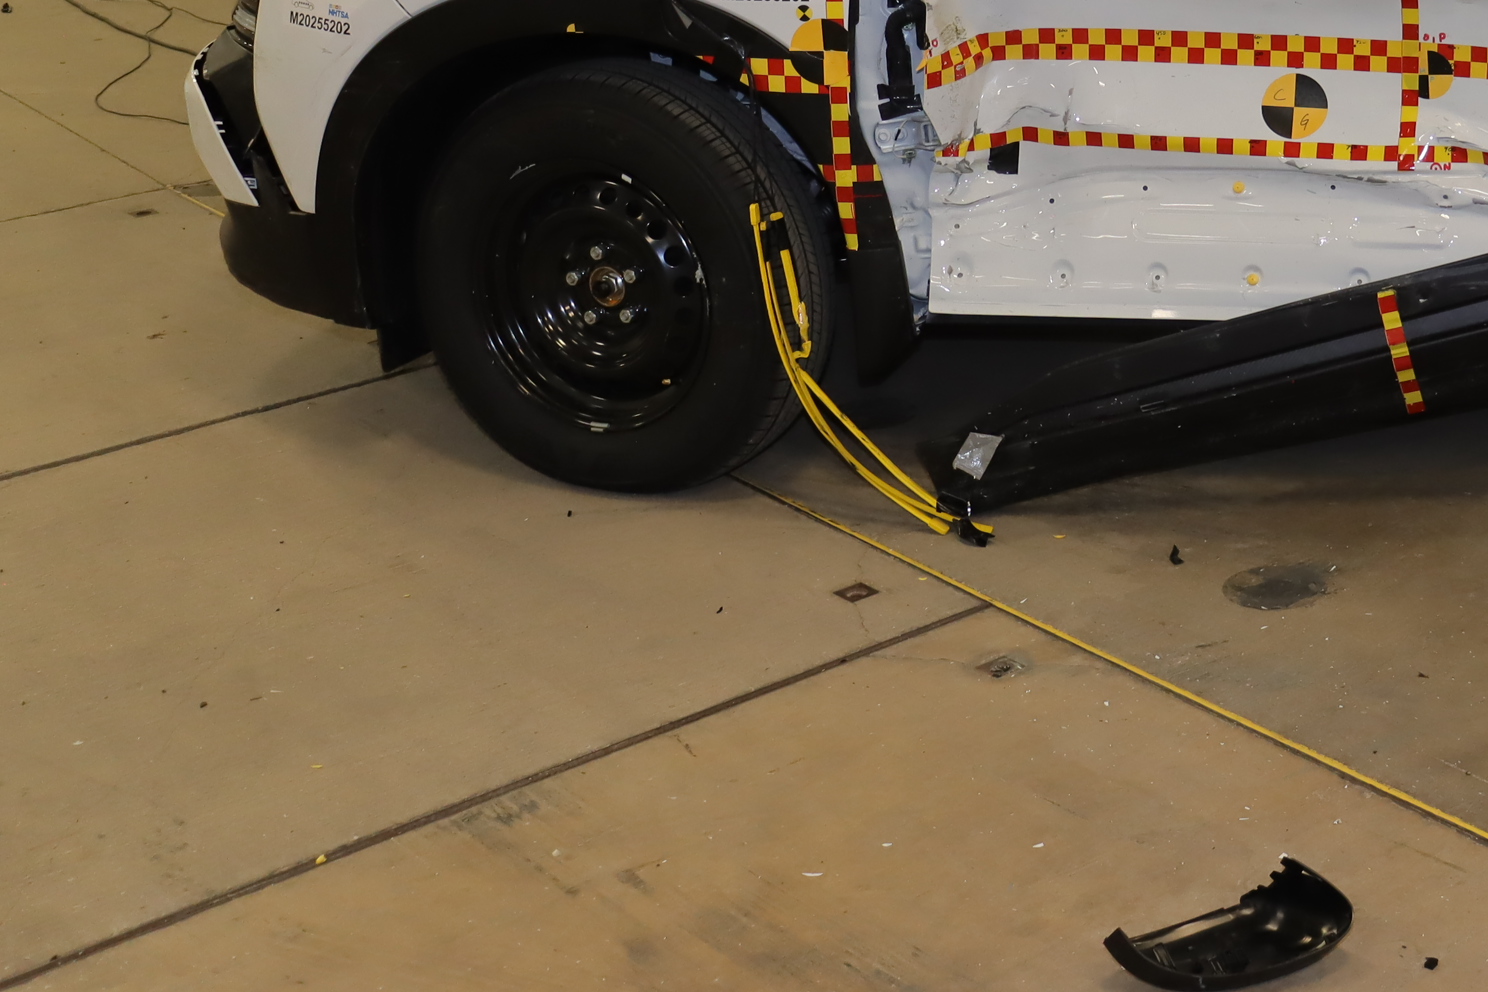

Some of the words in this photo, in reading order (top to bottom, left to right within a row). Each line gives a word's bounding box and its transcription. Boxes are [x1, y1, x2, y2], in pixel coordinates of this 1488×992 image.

[328, 9, 350, 19] NHTSA
[290, 11, 351, 35] M20255202
[1274, 88, 1286, 101] C
